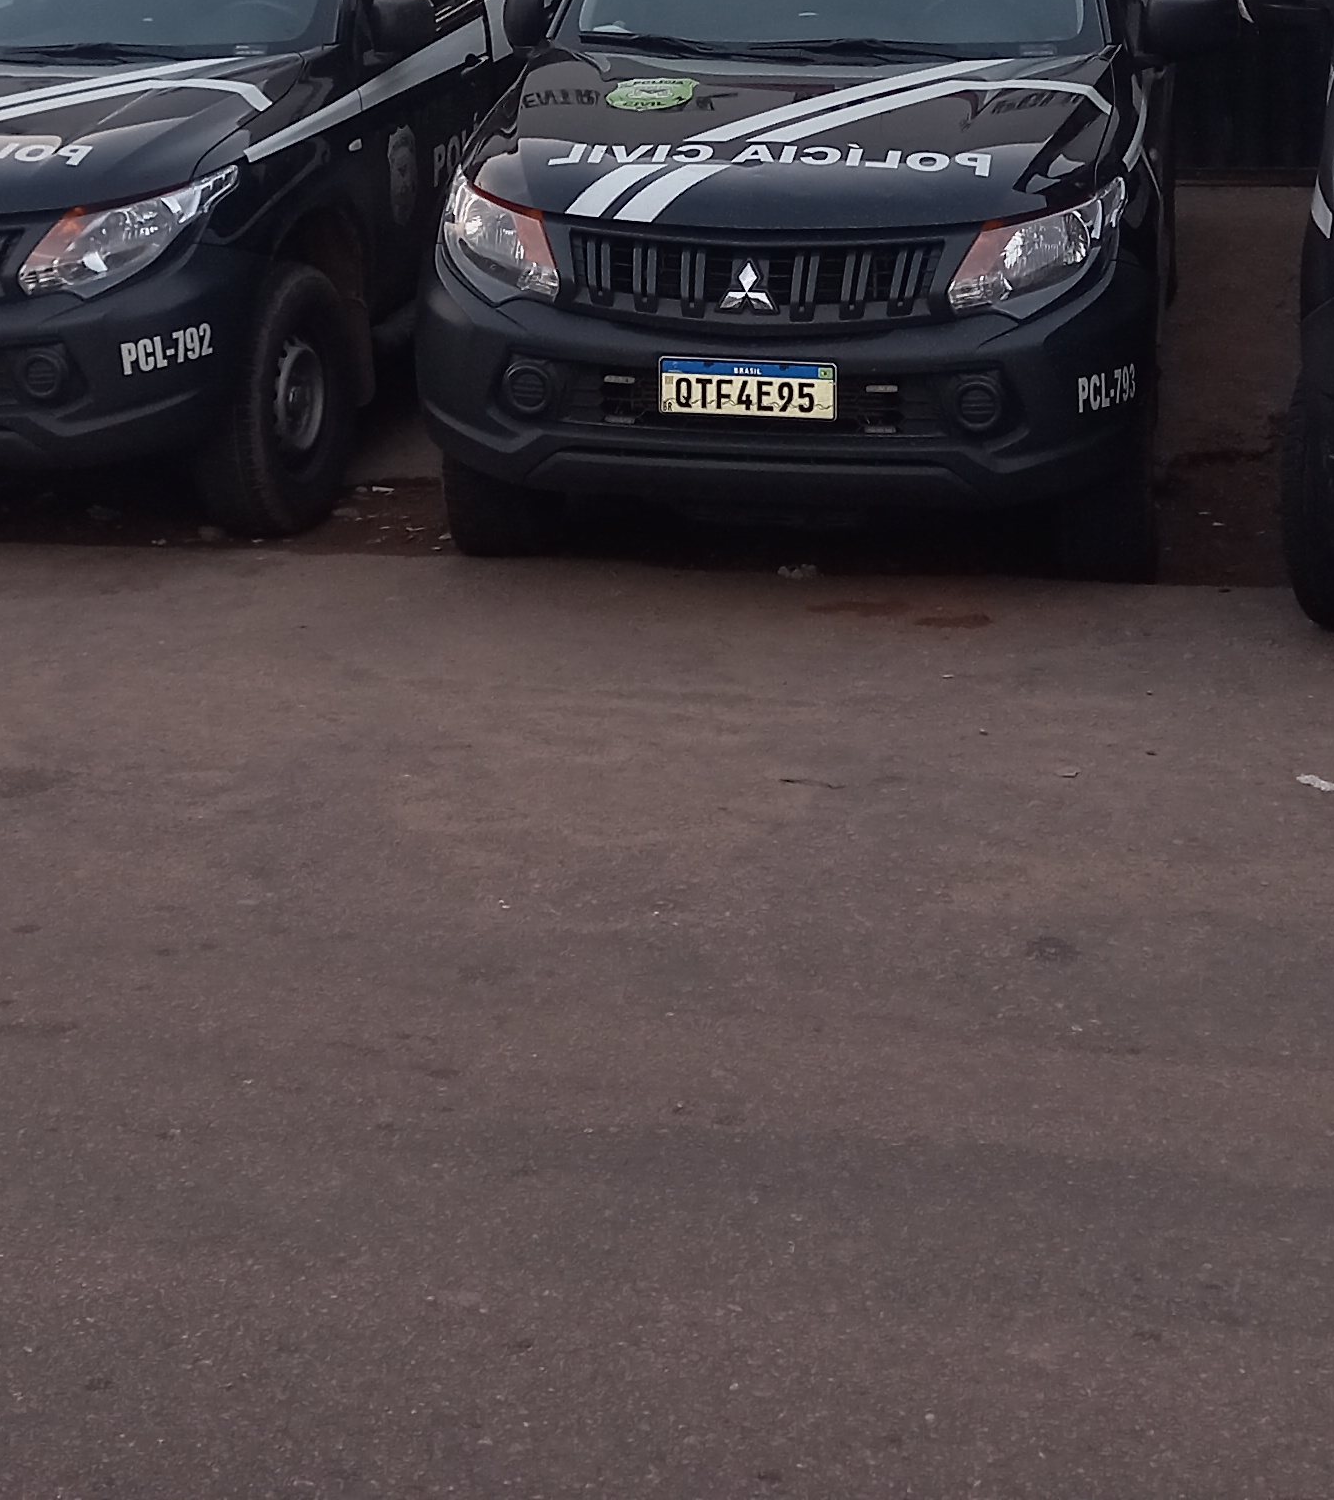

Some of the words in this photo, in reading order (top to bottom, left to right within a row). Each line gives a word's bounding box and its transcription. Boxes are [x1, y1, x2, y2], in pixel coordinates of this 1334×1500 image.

[120, 322, 214, 376] PCL-792
[733, 366, 763, 376] BRASIL
[674, 377, 816, 414] QTF4E95
[1077, 362, 1136, 414] PCL-793
